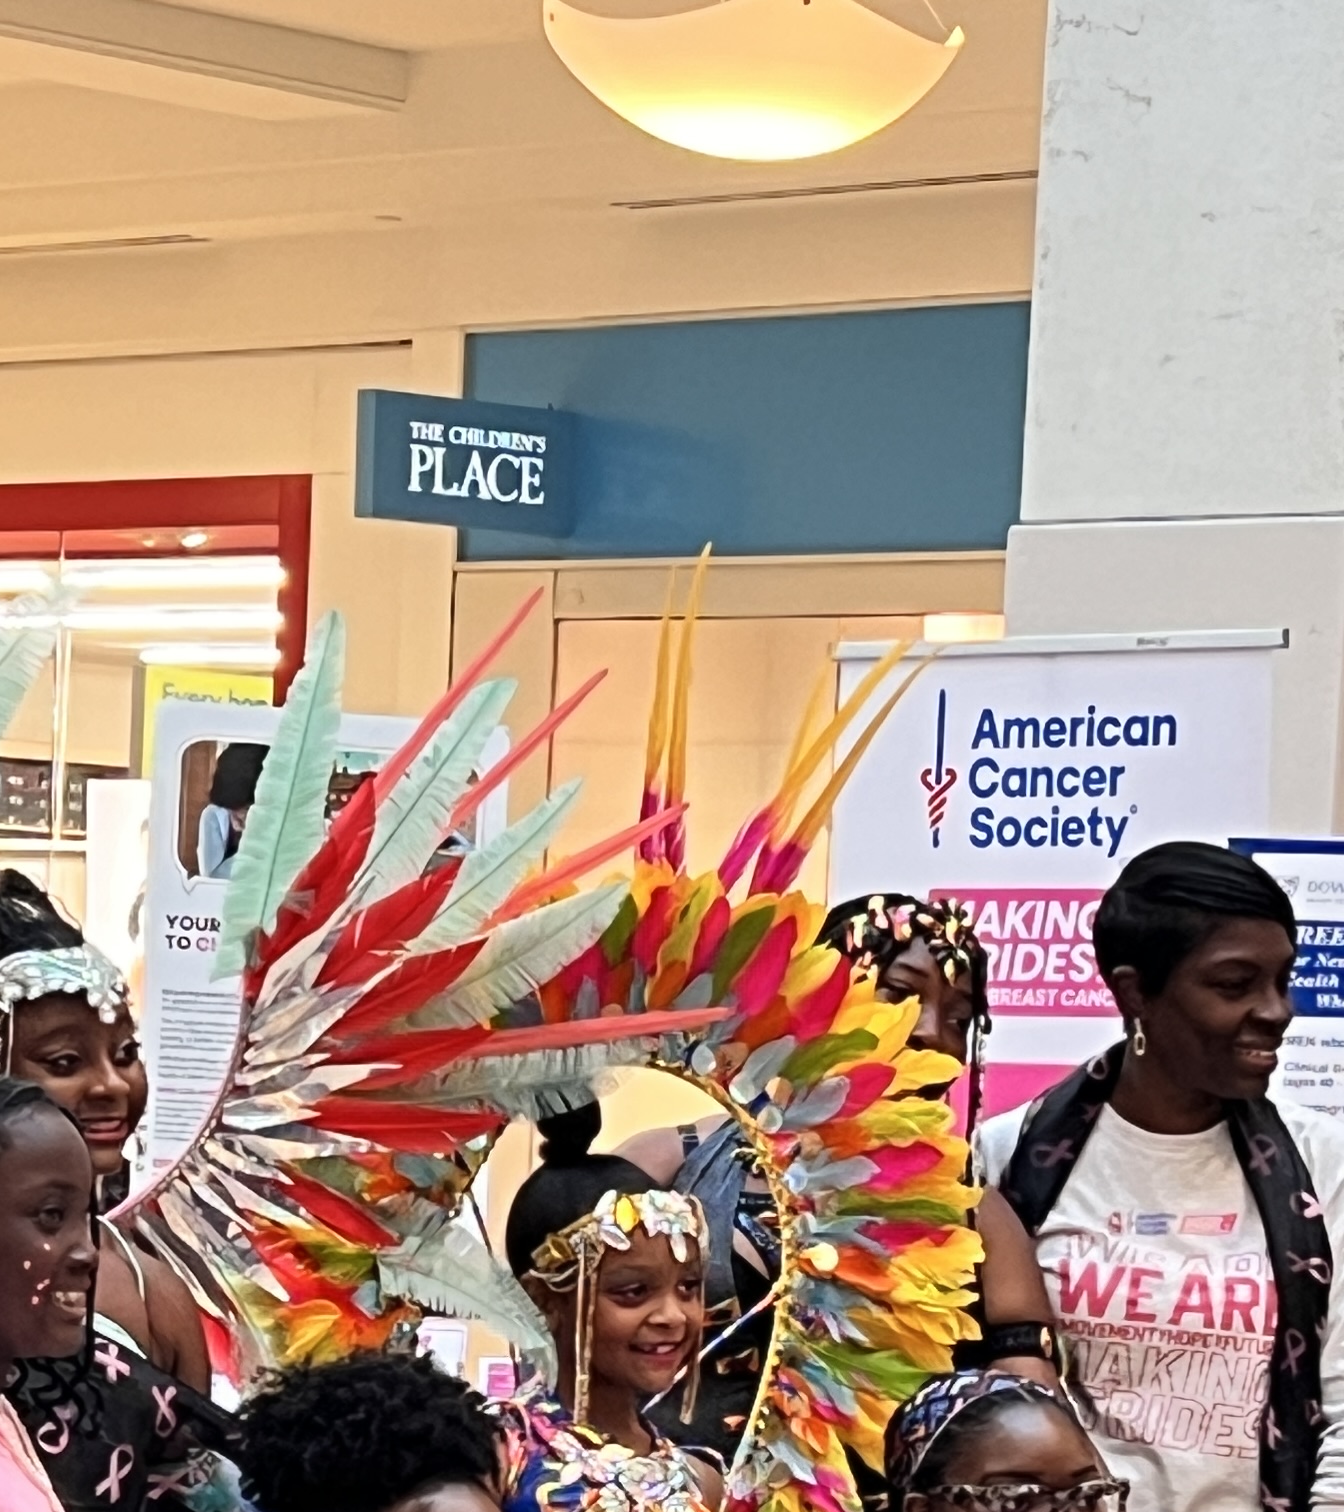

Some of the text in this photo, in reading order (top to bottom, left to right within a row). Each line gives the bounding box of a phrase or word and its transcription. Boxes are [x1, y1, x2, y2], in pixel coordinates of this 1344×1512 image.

[409, 421, 445, 443] THE
[407, 443, 545, 505] PLACE
[971, 704, 1177, 750] American
[969, 757, 1125, 798] Cancer
[166, 914, 221, 932] YOUR
[166, 935, 192, 950] TO
[987, 987, 1116, 1007] BREAST CANC
[1058, 1258, 1166, 1324] WE
